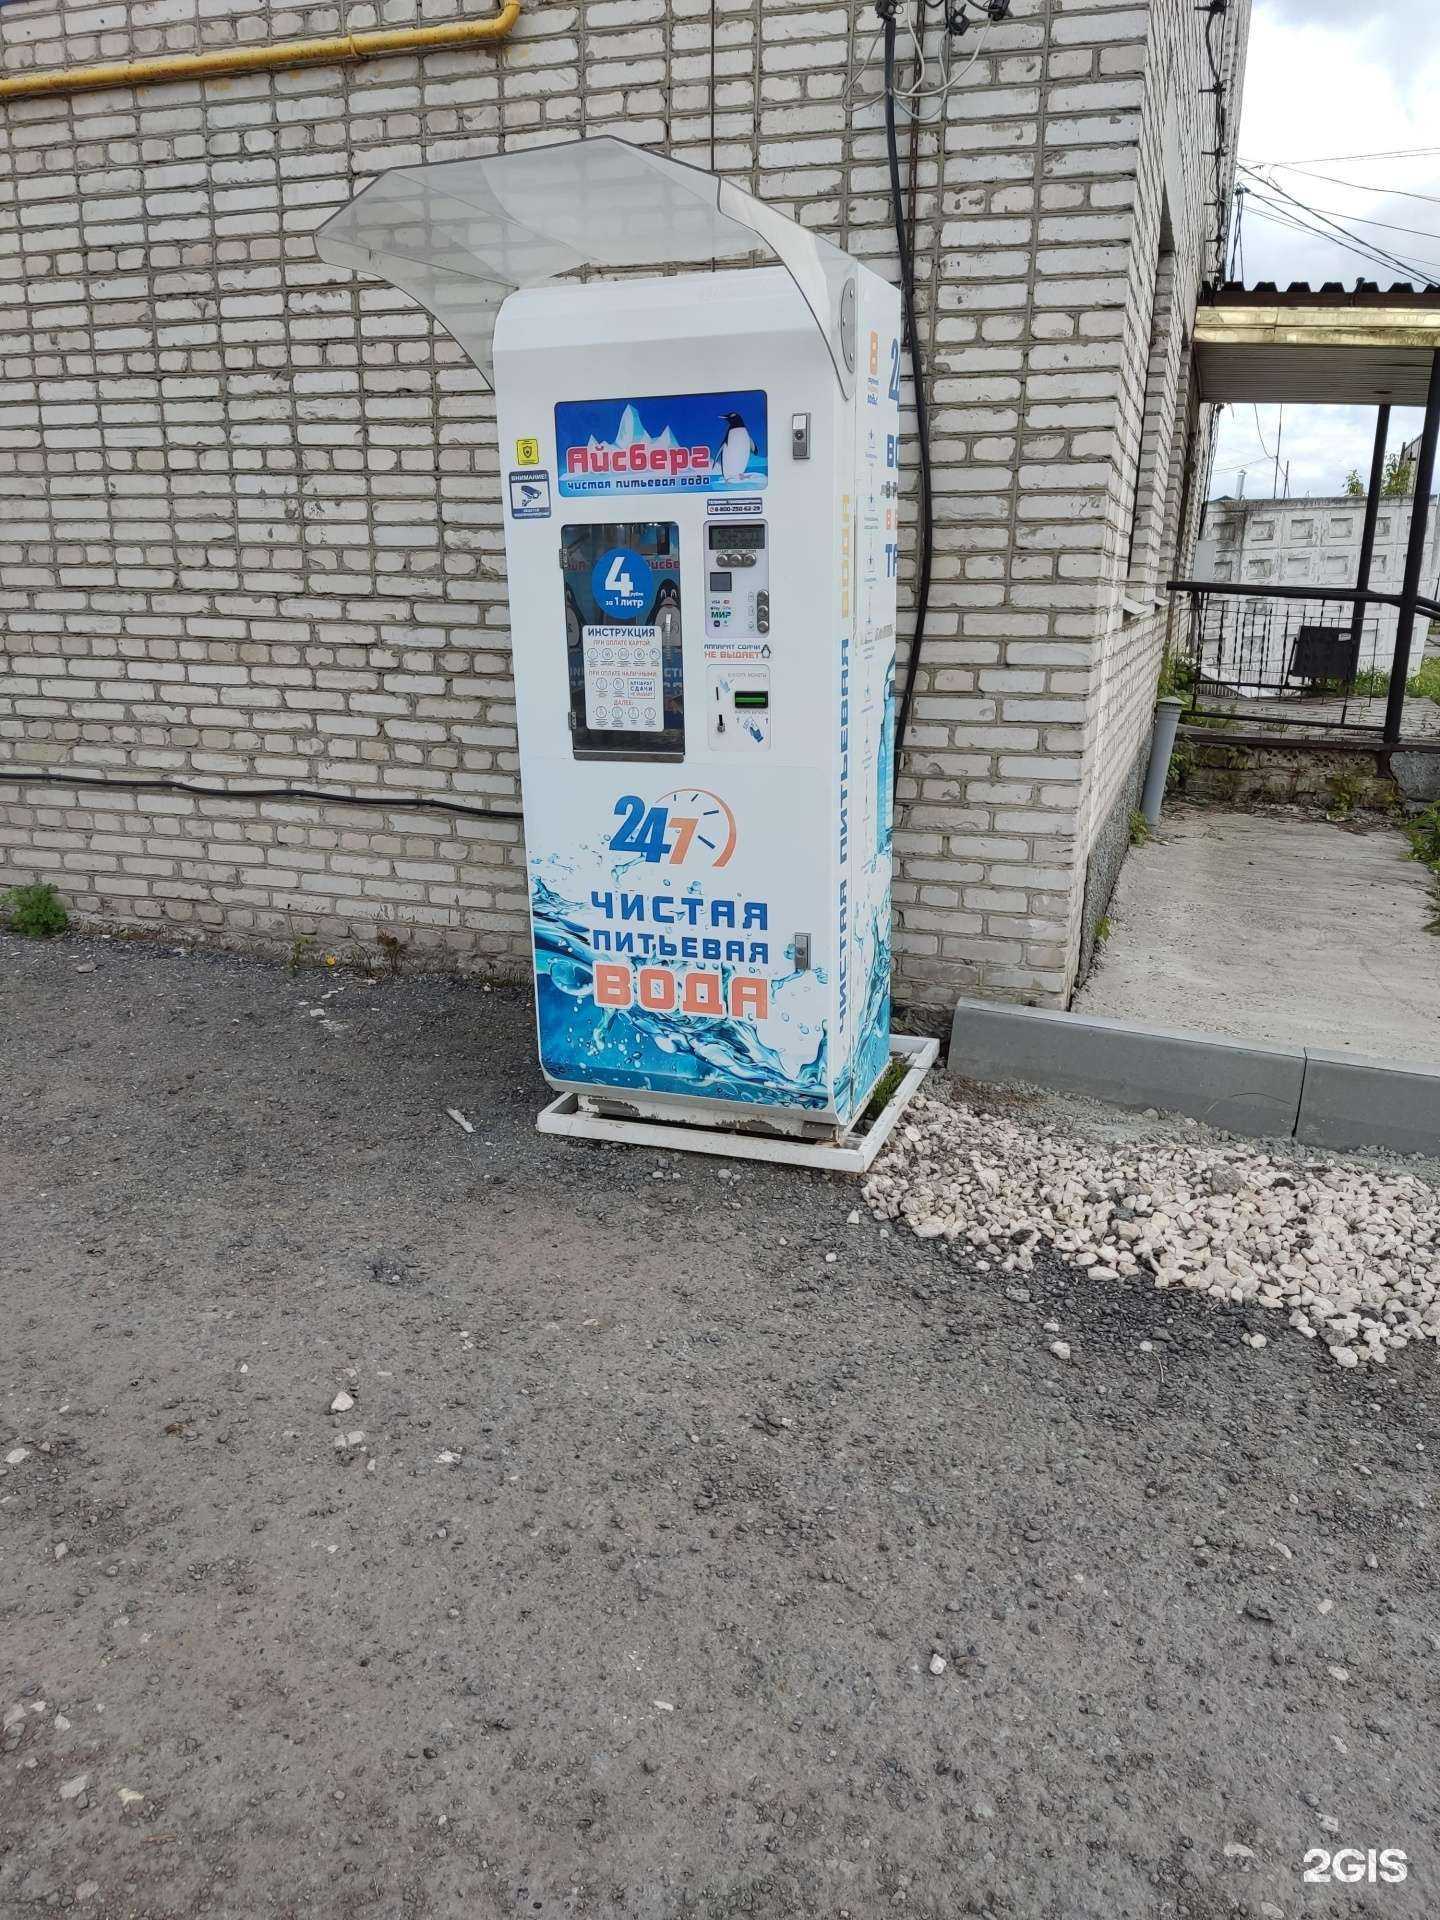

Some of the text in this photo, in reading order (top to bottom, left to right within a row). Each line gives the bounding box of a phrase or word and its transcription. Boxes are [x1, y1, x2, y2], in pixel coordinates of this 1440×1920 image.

[567, 443, 710, 475] Айсберг
[567, 475, 710, 490] чистая питьевая вода
[605, 556, 633, 597] 4
[614, 597, 619, 606] 1
[620, 599, 644, 608] литр
[711, 611, 732, 619] МИР
[588, 628, 656, 638] ИНСТРУКЦИЯ
[591, 890, 768, 930] ЧИСТАЯ
[592, 929, 769, 964] ПИТЬЕВАЯ
[595, 963, 769, 1020] ВОДА
